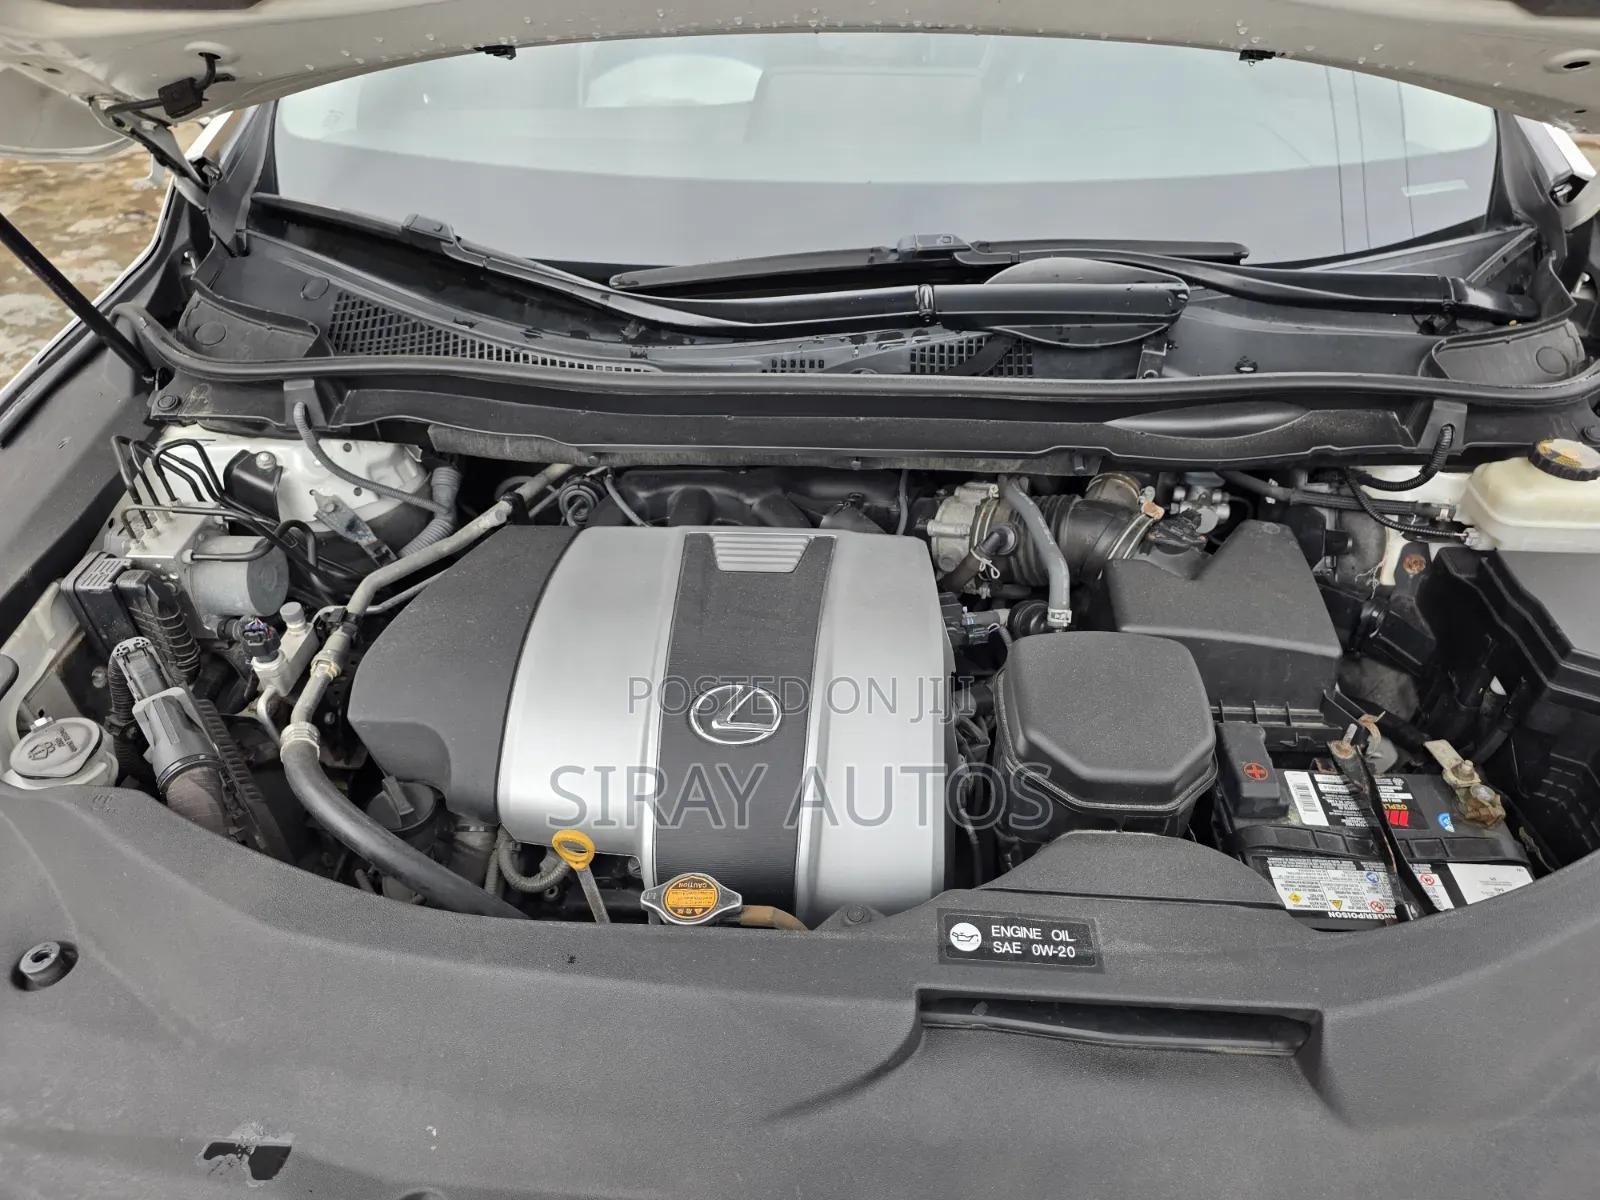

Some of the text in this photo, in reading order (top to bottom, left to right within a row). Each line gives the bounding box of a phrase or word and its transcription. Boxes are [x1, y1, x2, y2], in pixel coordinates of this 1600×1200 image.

[1328, 911, 1397, 920] ANGER/POISON
[991, 924, 1077, 942] ENGINE OIL
[992, 941, 1076, 958] SAE 0W-20
